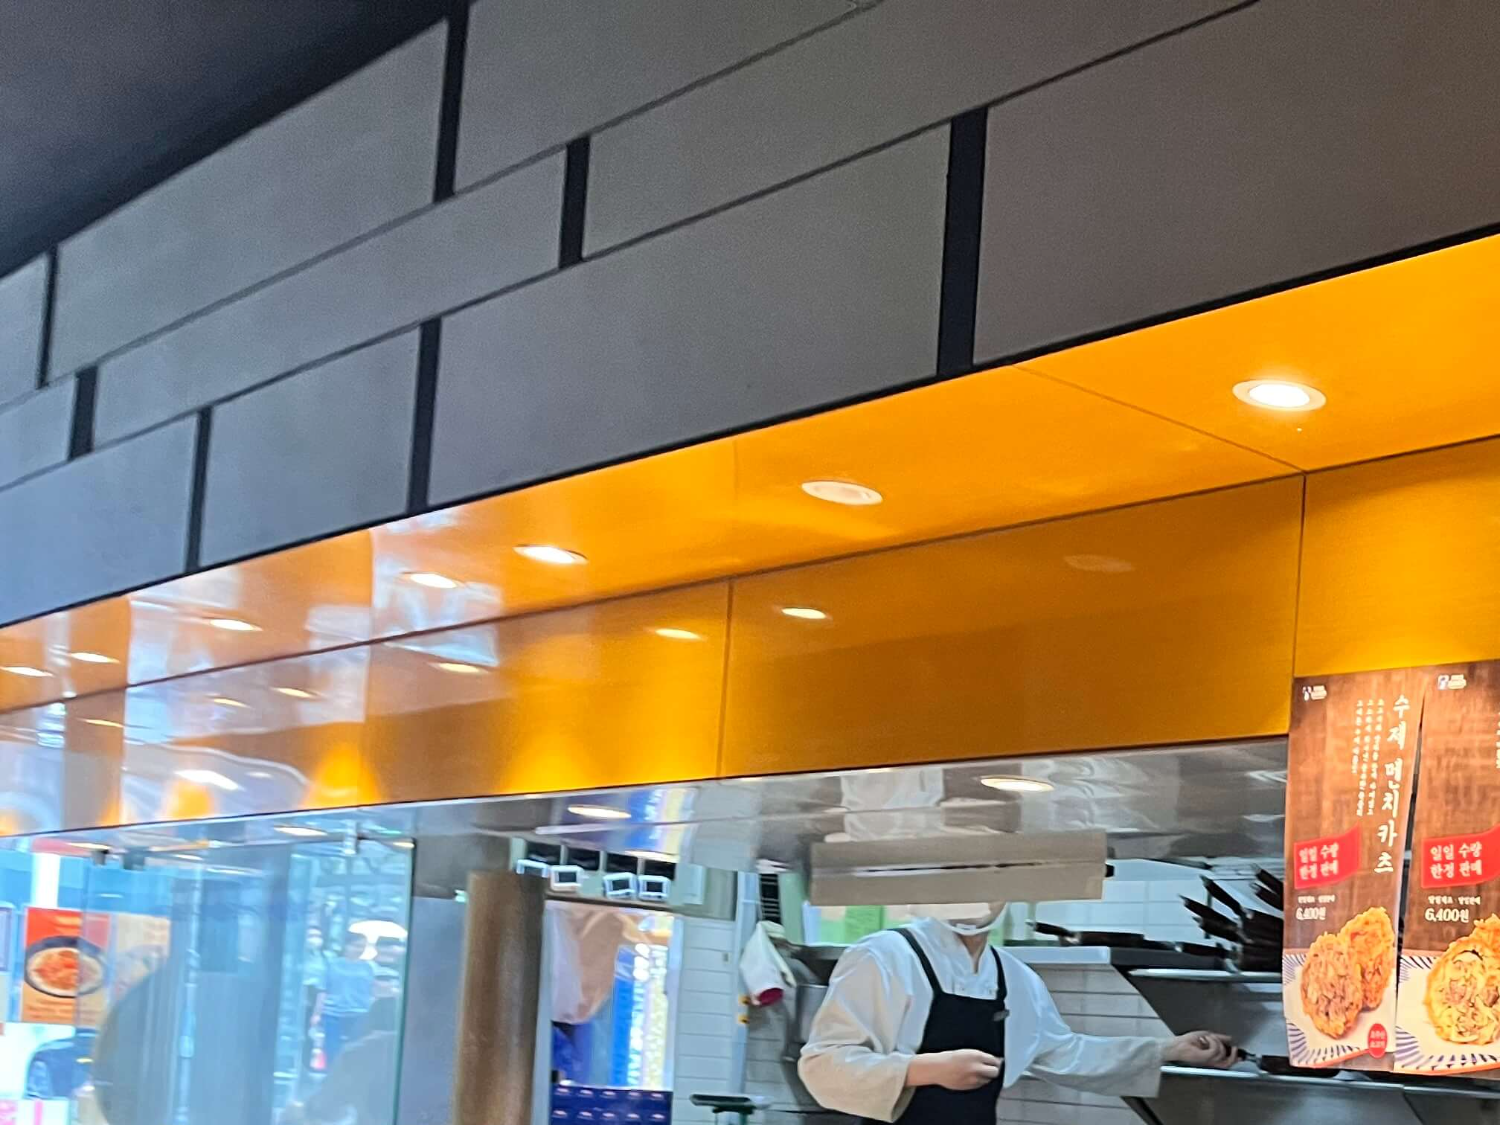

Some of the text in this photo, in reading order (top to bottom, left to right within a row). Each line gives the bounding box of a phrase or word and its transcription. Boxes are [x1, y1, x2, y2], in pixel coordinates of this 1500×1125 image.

[1374, 694, 1410, 874] 수제 멘치카츠
[1430, 841, 1482, 862] 일일 수량
[1430, 859, 1483, 879] 한정 판매
[1424, 908, 1470, 923] 6,400원
